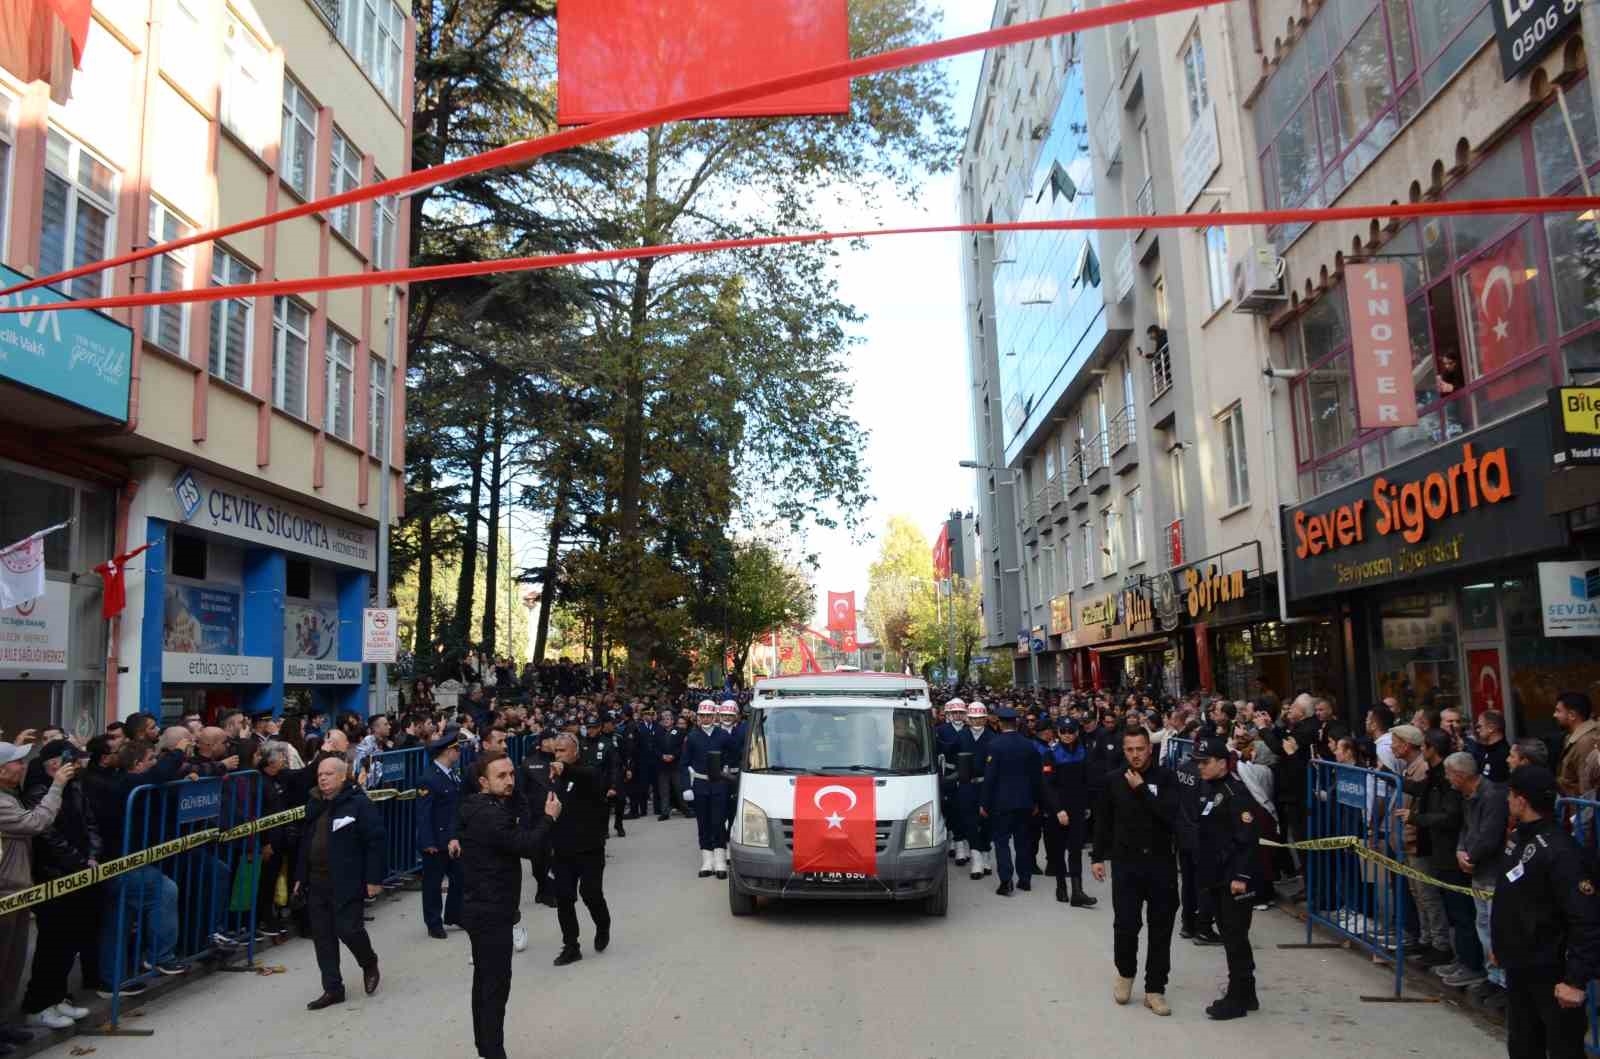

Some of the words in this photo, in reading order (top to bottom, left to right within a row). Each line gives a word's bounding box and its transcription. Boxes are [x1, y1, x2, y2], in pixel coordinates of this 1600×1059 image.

[1512, 5, 1558, 61] 0506
[1364, 268, 1388, 291] 1.
[1367, 298, 1399, 422] NOTER
[208, 488, 262, 531] ÇEVİK
[266, 505, 329, 550] SİGORTA
[1294, 499, 1367, 559] Sever
[1373, 442, 1512, 544] Sigorta
[56, 872, 89, 893] POLİS
